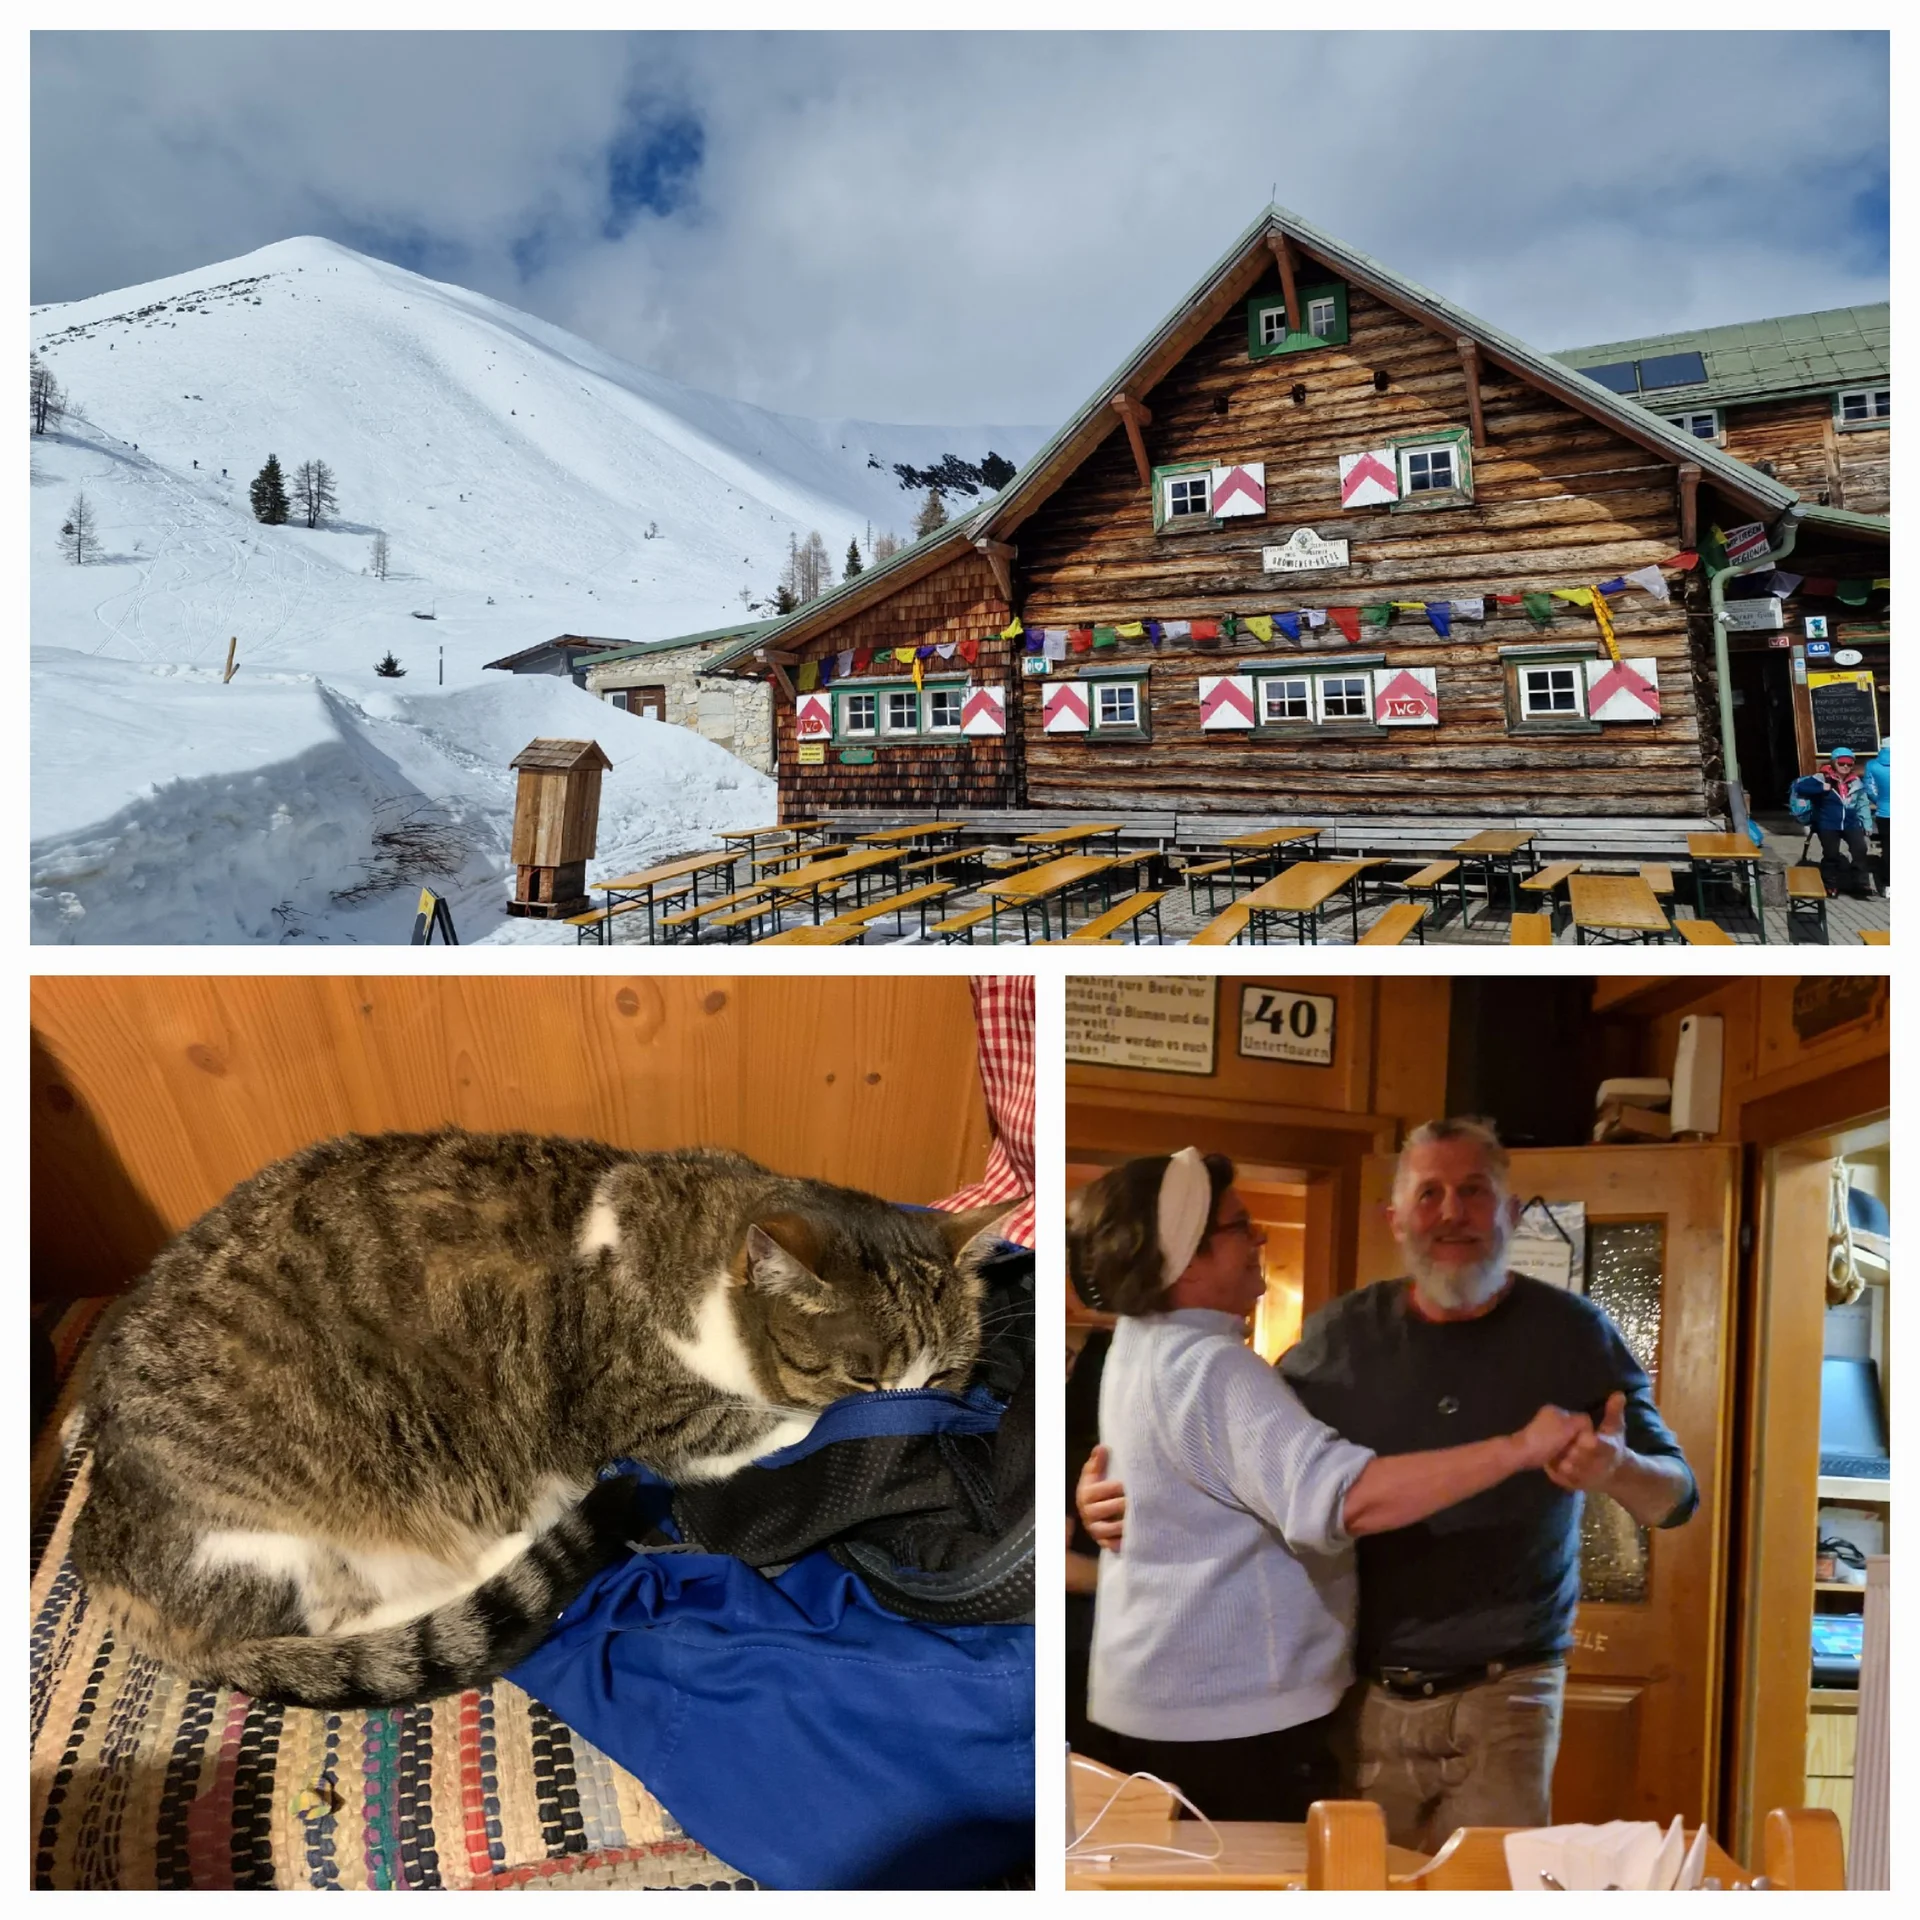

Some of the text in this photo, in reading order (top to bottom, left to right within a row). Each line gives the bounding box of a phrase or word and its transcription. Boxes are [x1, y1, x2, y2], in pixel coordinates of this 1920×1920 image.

[1732, 540, 1768, 564] REGIONAL
[804, 722, 819, 733] WC
[1117, 980, 1143, 992] eure
[1124, 1005, 1167, 1021] Blumen
[1168, 1011, 1189, 1024] und
[1254, 993, 1317, 1039] 40
[1085, 1029, 1122, 1044] Kinder
[1124, 1036, 1164, 1049] werden
[1166, 1040, 1179, 1051] es
[1182, 1041, 1209, 1053] euch
[1243, 1035, 1330, 1058] Untertauern
